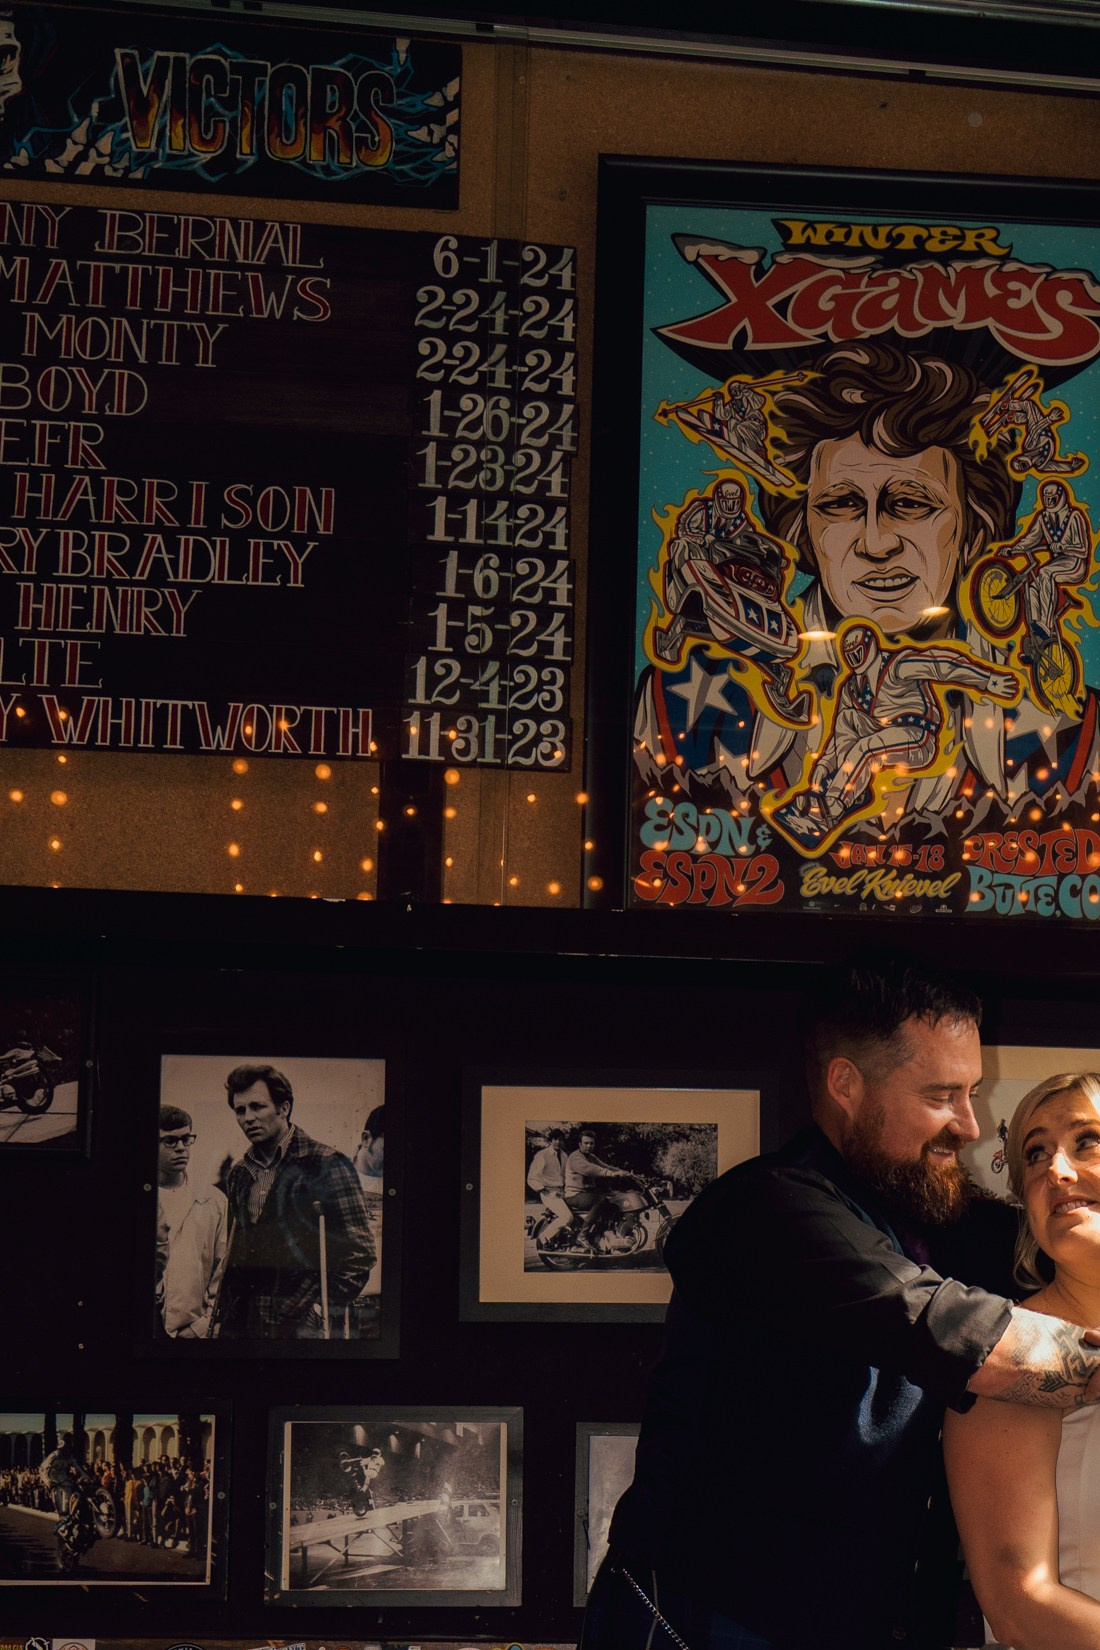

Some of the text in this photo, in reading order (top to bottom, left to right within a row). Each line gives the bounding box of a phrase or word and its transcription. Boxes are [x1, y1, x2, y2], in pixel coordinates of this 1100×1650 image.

[114, 47, 398, 167] VICTORS
[94, 209, 324, 270] BERNAL
[432, 235, 576, 292] 6-1-24
[0, 256, 331, 321] MATTHEWS
[414, 285, 577, 343] 2-24-24
[21, 311, 228, 368] MONTY
[415, 336, 577, 396] 2-24-24
[0, 362, 148, 416] BOYD
[420, 389, 578, 452] 1-26-24
[415, 441, 569, 498] 1-23-24
[11, 472, 335, 534] HARRISON
[425, 495, 568, 551] 1-14-24
[52, 529, 318, 587] BRADLEY
[434, 549, 572, 607] 1-6-24
[14, 582, 202, 637] HENRY
[426, 602, 572, 661] 1-5-24
[407, 655, 565, 713] 12-4-23
[37, 694, 372, 756] WHITWORTH
[402, 710, 567, 766] 11-31-23
[640, 798, 773, 855] ESPN &
[829, 841, 886, 869] JAN
[634, 852, 785, 906] ESPN2
[800, 866, 866, 898] Evel
[861, 868, 962, 901] Knievel
